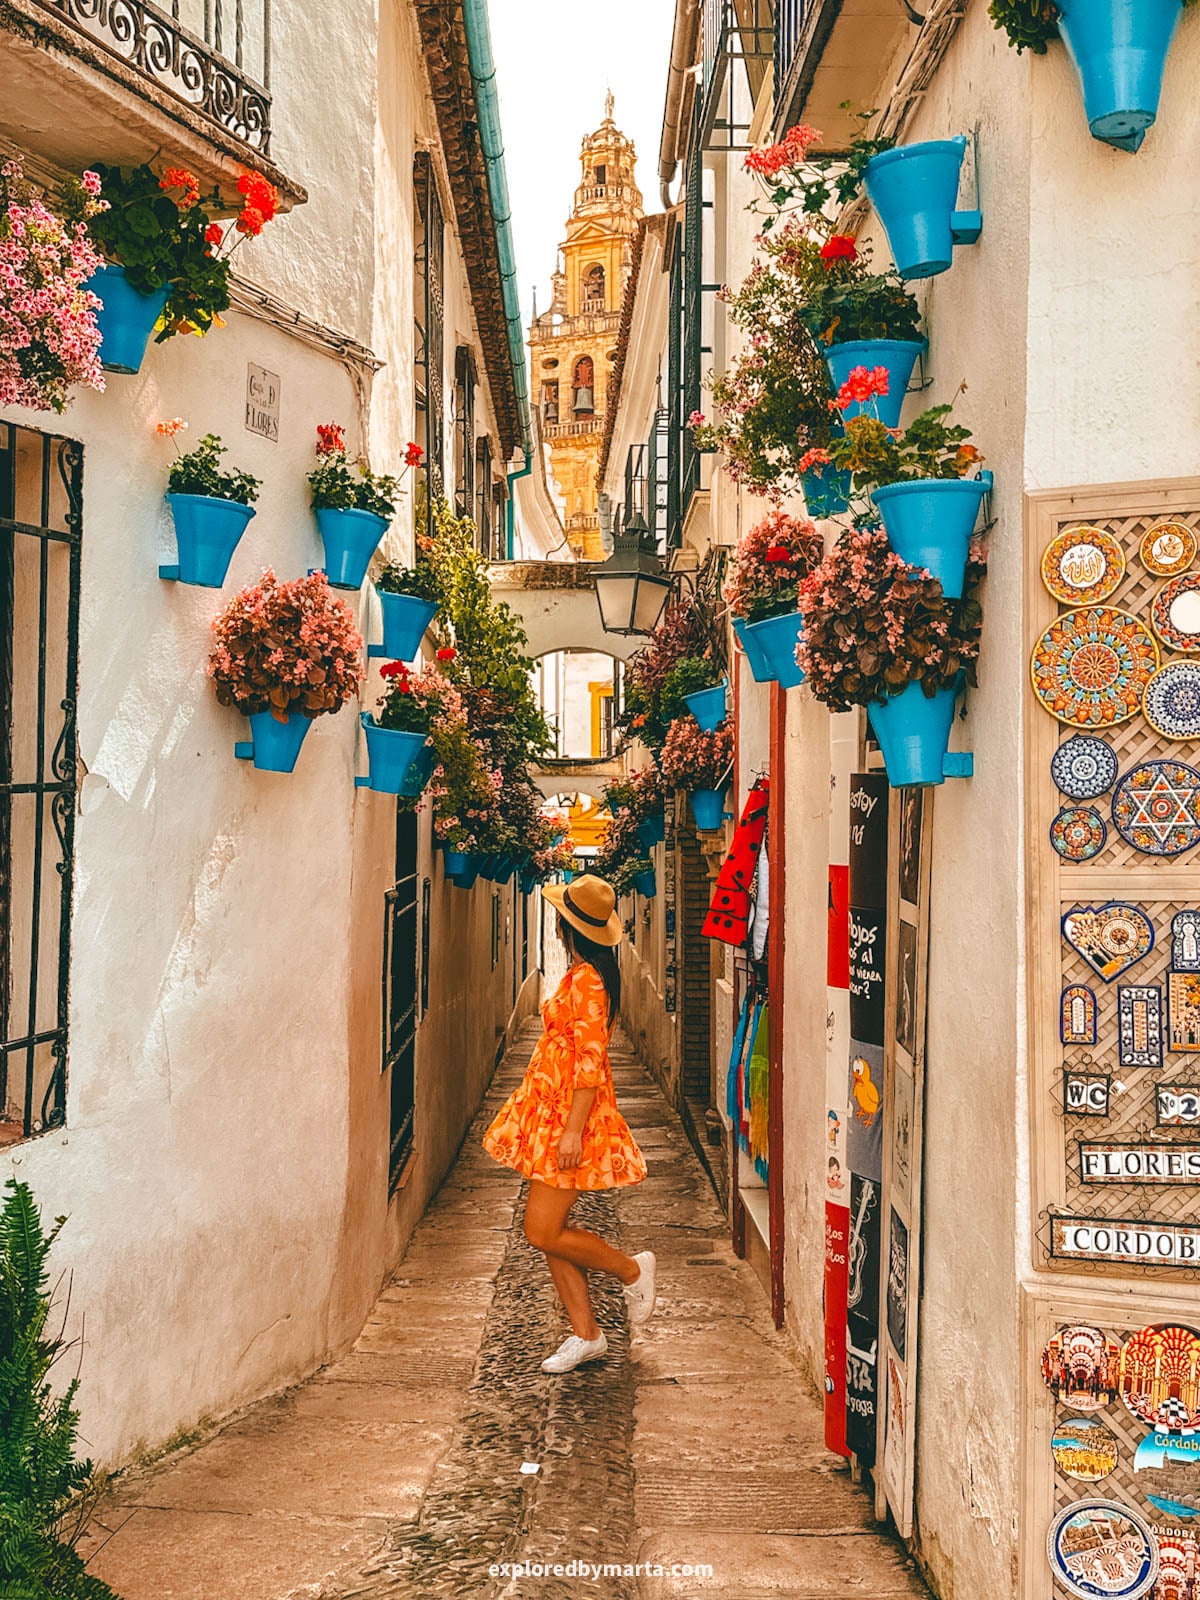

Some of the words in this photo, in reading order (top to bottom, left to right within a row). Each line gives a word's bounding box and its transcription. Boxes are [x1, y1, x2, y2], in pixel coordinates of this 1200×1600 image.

[245, 403, 278, 437] FLORES
[1068, 1085, 1107, 1106] WC
[1180, 1099, 1198, 1116] 2
[1082, 1152, 1200, 1177] FLORES
[1073, 1227, 1200, 1260] CORDOB
[850, 1396, 875, 1417] yoga
